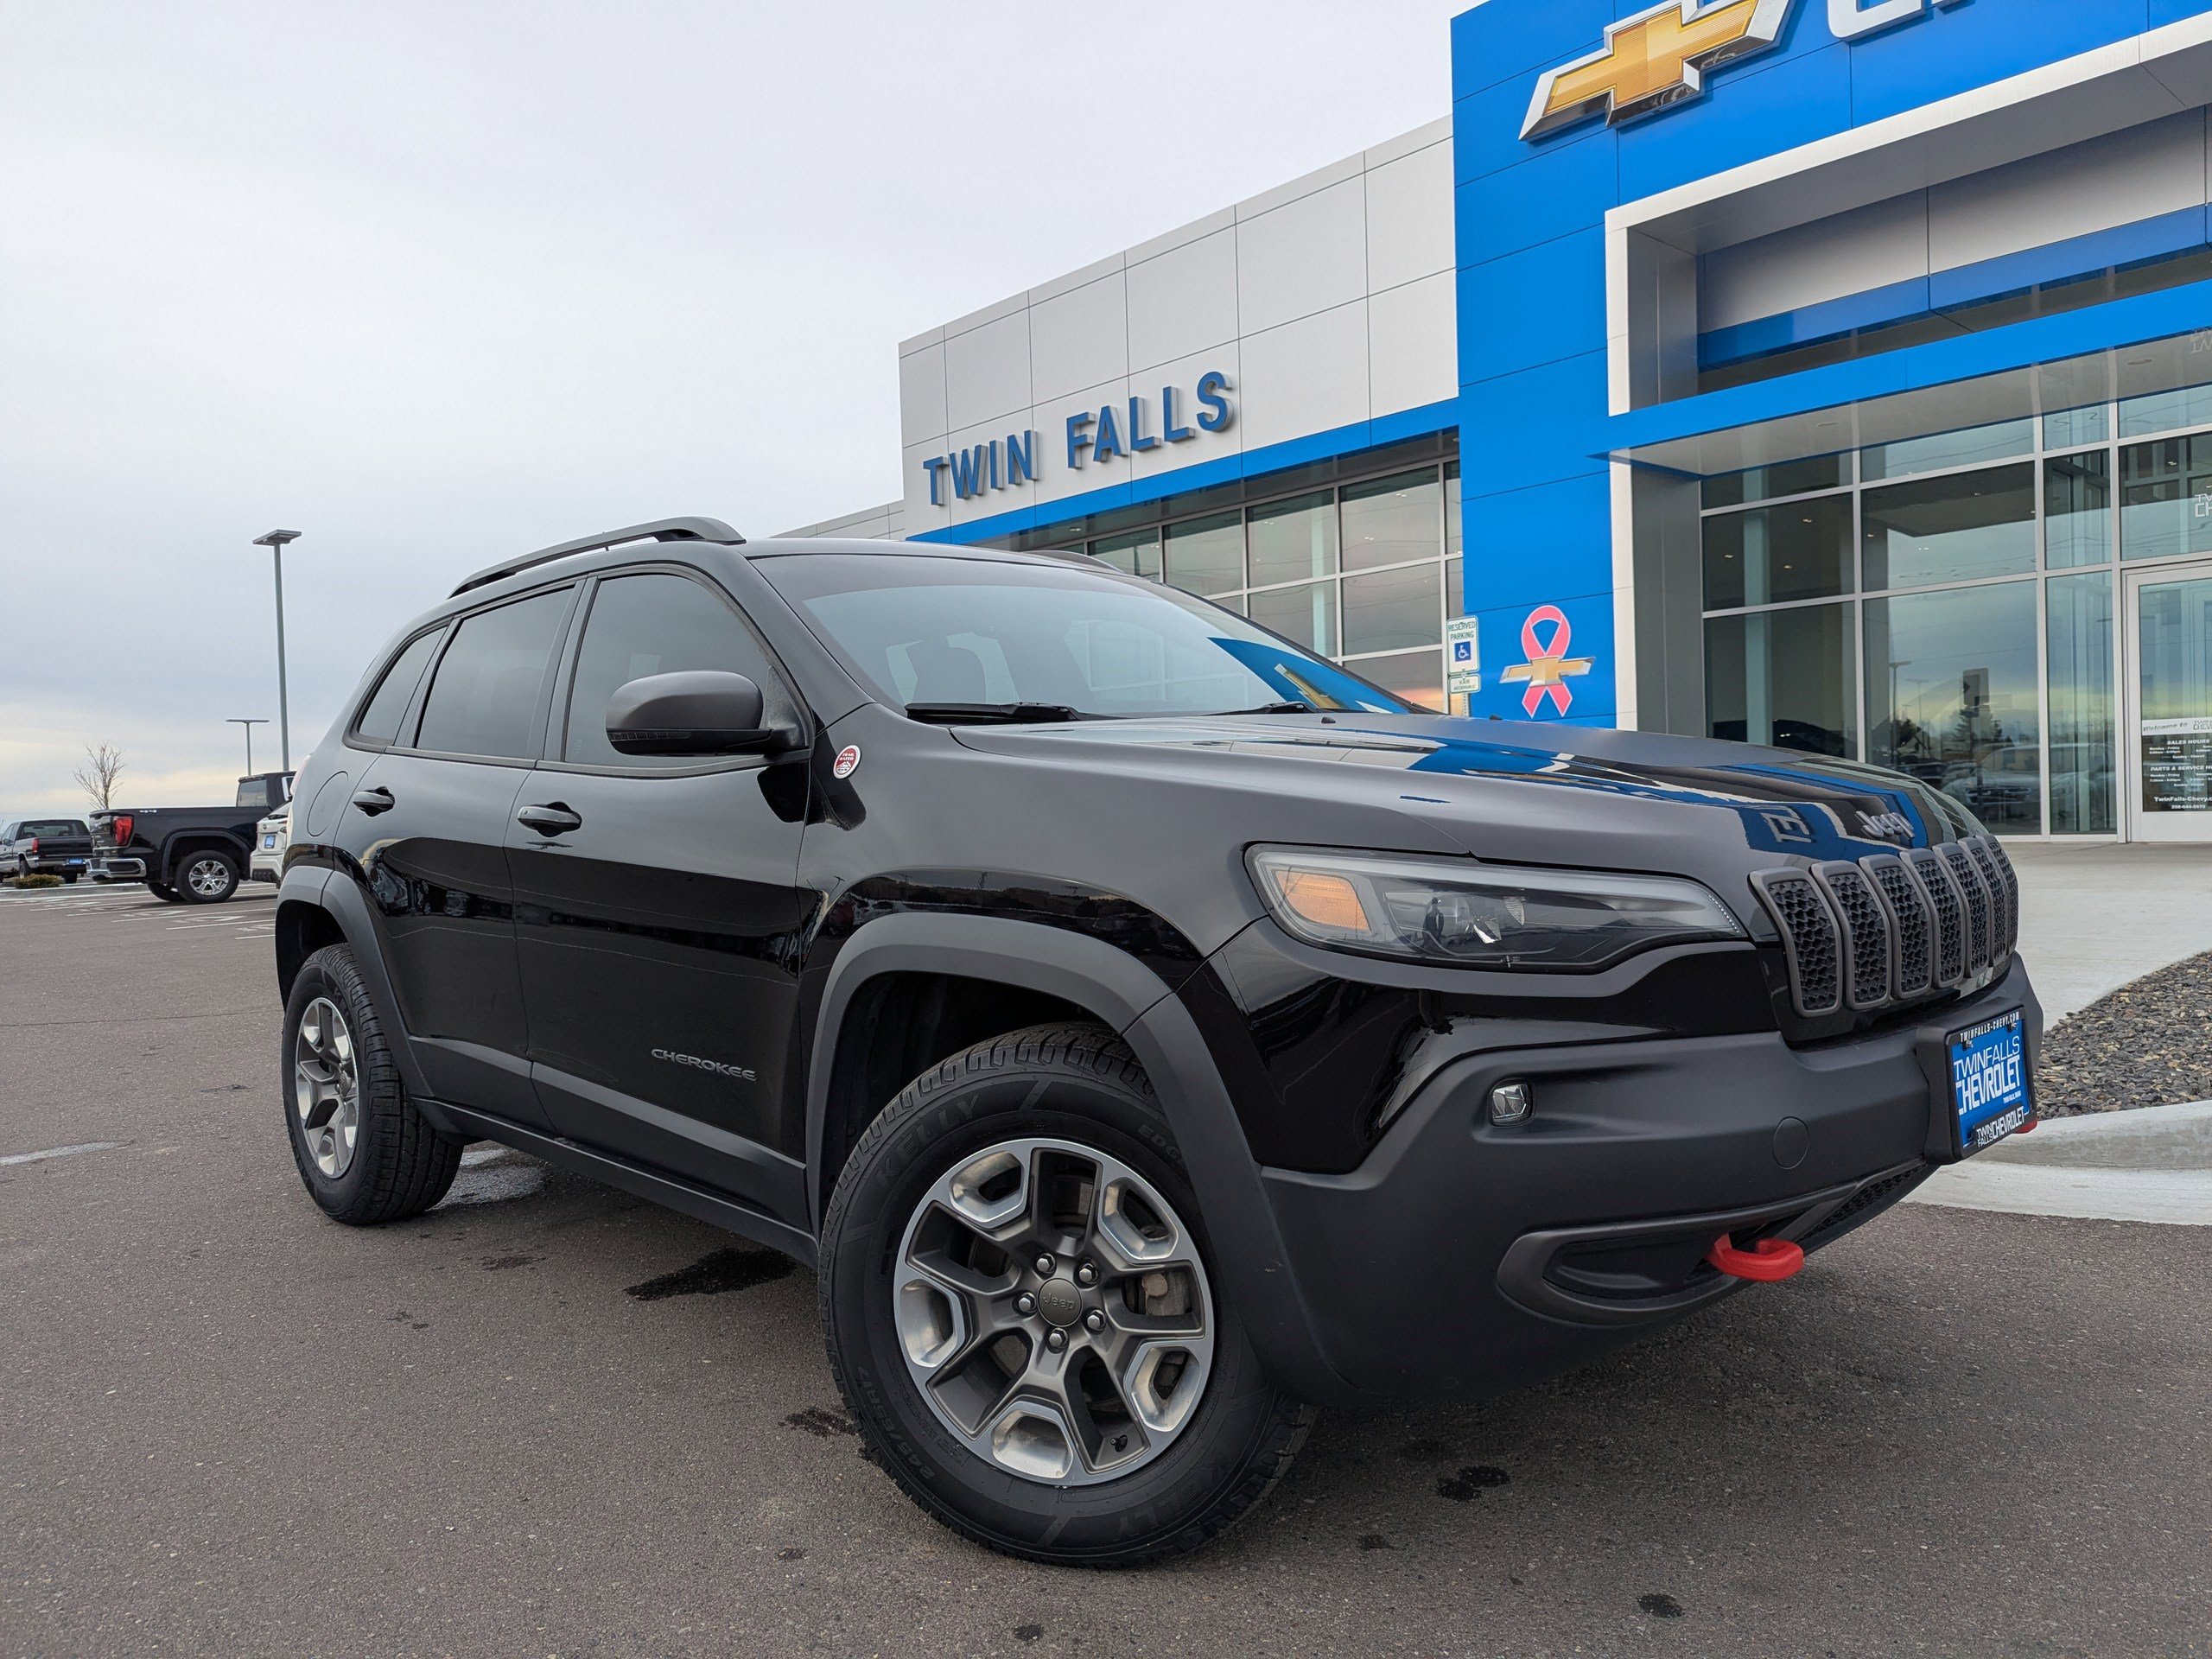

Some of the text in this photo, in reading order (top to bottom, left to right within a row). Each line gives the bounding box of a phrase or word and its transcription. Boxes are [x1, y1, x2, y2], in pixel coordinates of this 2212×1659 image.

[923, 372, 1234, 506] TWIN FALLS
[1448, 621, 1476, 632] RESERVED
[1450, 632, 1474, 640] PARKING
[1854, 810, 1916, 838] Jeep
[651, 1048, 758, 1081] CHEROKEE
[1955, 1058, 2021, 1116] CHEVROLET
[874, 1094, 978, 1179] KELLY
[1976, 1123, 1993, 1139] TWIN
[1991, 1105, 2024, 1140] CHEVROLET
[1137, 1123, 1182, 1162] EDG
[1977, 1133, 1993, 1147] FALLS
[1042, 1293, 1076, 1312] Jeep
